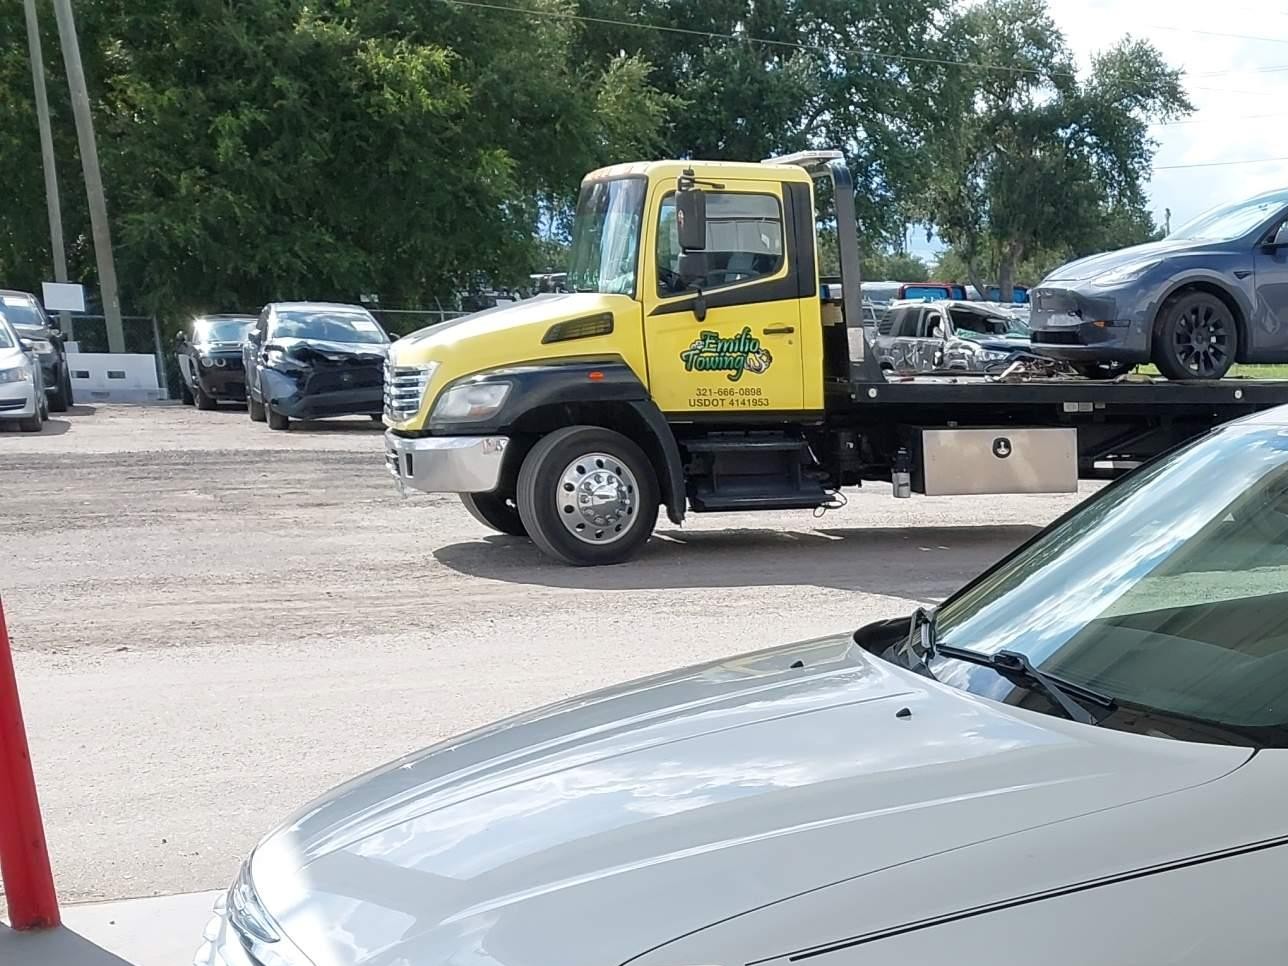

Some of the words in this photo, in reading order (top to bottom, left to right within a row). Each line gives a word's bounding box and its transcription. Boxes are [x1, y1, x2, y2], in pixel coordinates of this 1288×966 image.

[700, 327, 760, 353] Emilio
[680, 350, 746, 381] Towing
[695, 387, 762, 397] 321-666-0898
[688, 398, 726, 408] USDOT
[728, 398, 770, 407] 4141953
